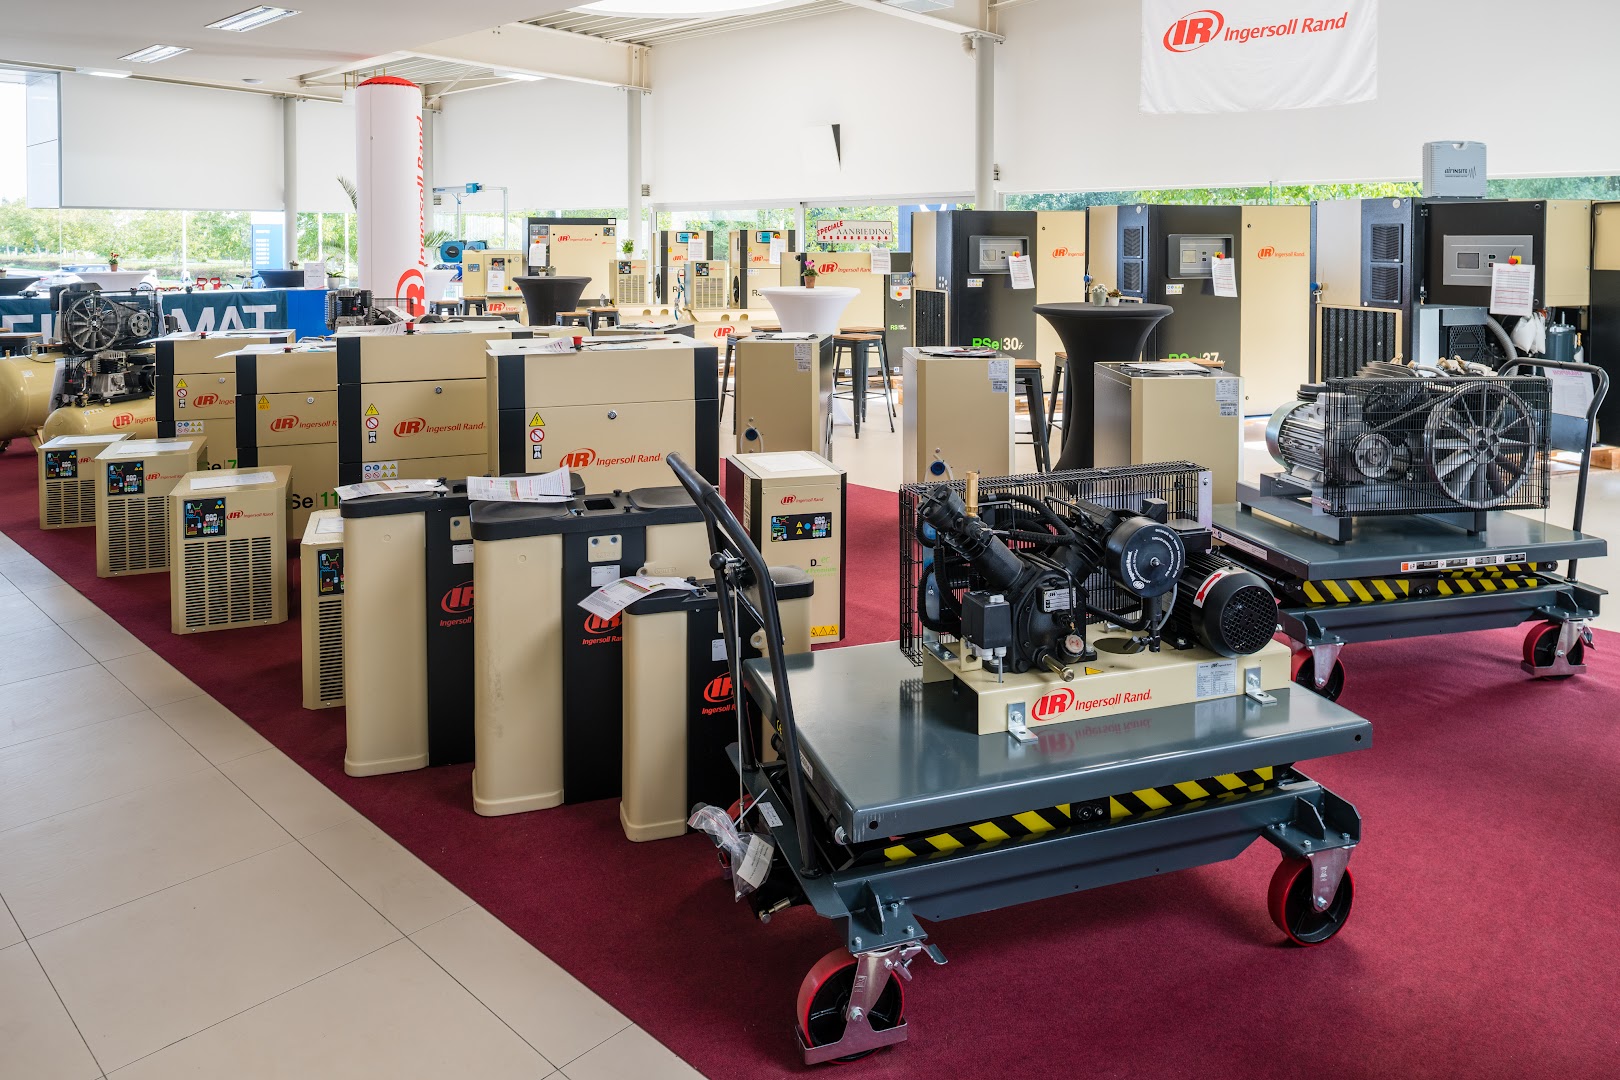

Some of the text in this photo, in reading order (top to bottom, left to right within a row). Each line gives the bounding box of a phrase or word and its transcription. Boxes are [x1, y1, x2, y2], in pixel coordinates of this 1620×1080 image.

[1170, 11, 1349, 48] IR Ingersoll Rand
[816, 220, 843, 236] SPECIALE
[1054, 248, 1066, 257] IR
[1260, 248, 1272, 258] IR
[820, 263, 836, 273] IR
[197, 394, 215, 406] IR
[116, 414, 156, 427] IR Ingerso
[273, 417, 296, 430] IR
[299, 420, 330, 429] Ingersoll
[397, 420, 484, 435] IR Ingersoll Rand
[564, 451, 661, 468] IR Ingersoll Rand
[293, 493, 314, 510] Se
[782, 496, 795, 504] IR
[228, 511, 242, 519] IR
[440, 616, 472, 627] Ingersoll
[582, 636, 611, 645] Ingersoll
[702, 703, 731, 715] Ingersoll
[1037, 689, 1152, 717] IR Ingersoll Rand
